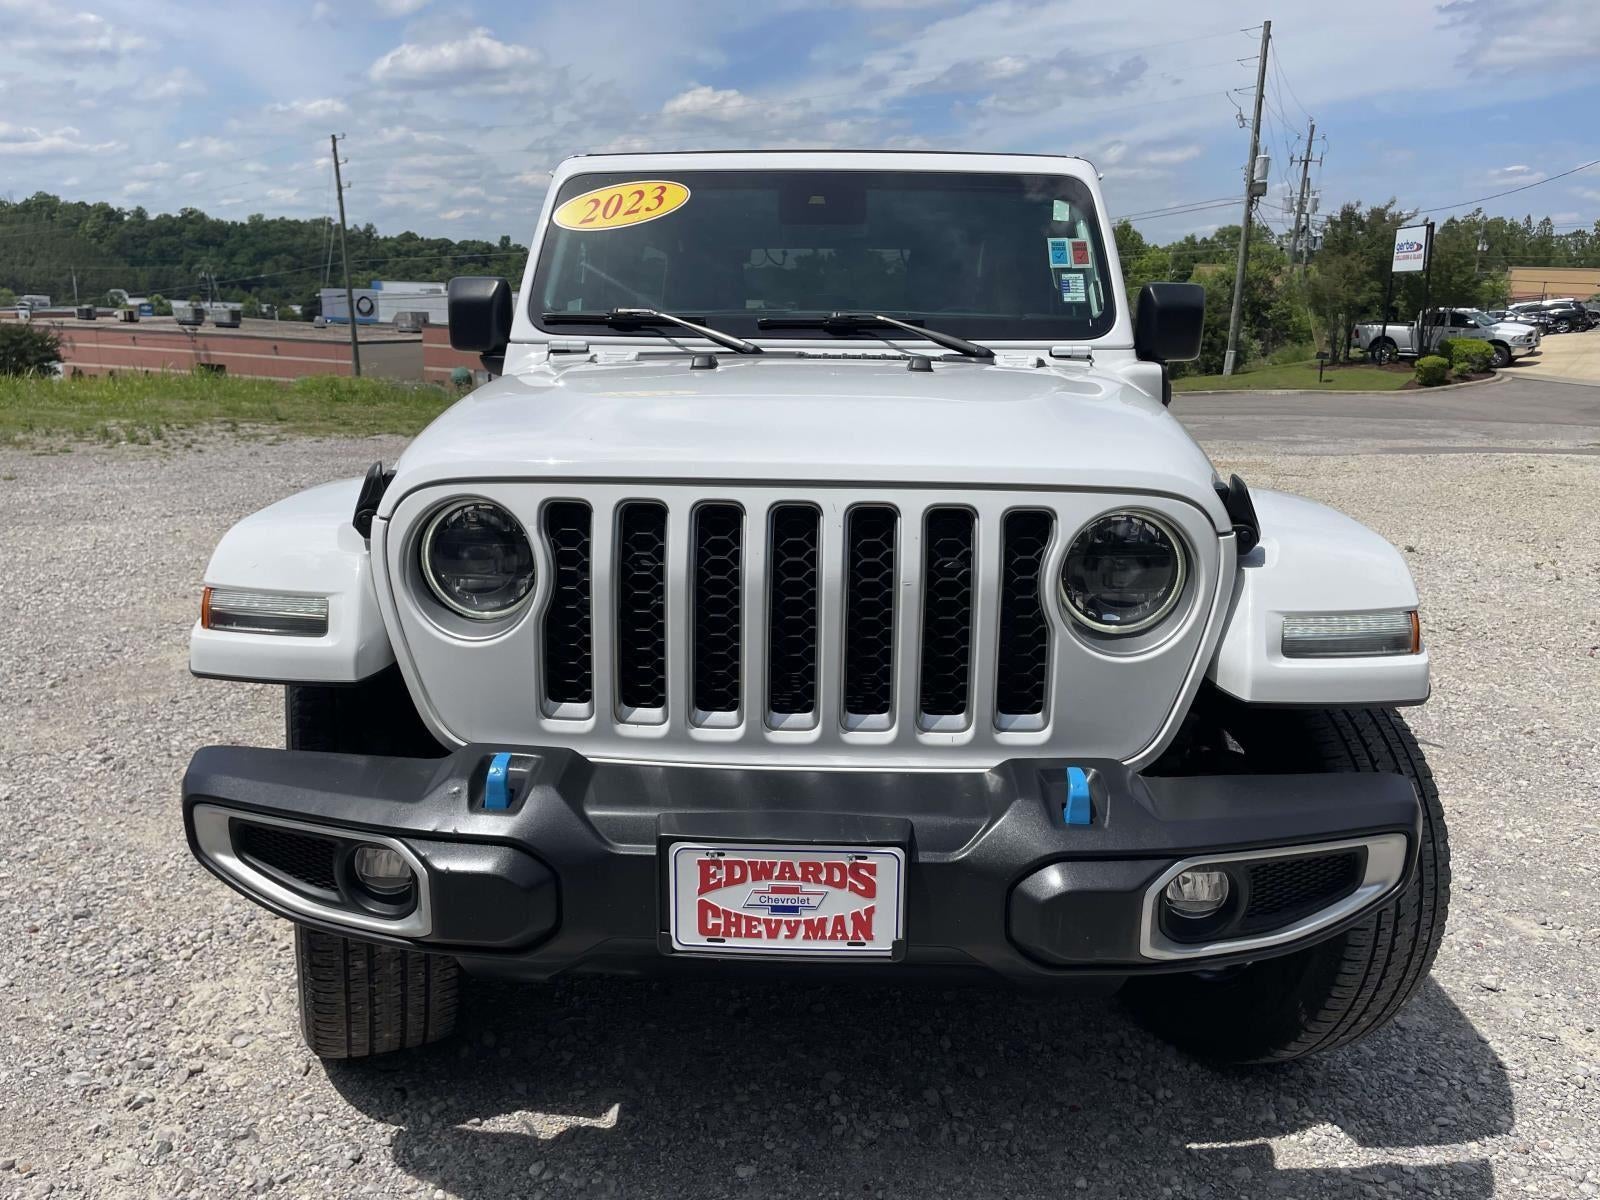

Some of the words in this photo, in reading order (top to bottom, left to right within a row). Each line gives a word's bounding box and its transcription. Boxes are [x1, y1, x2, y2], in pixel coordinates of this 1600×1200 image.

[578, 185, 667, 225] 2023
[1396, 240, 1416, 254] gerber
[697, 858, 877, 899] EDWARDS
[697, 898, 876, 941] CHEVYMAN
[759, 895, 811, 906] Chevrolet
